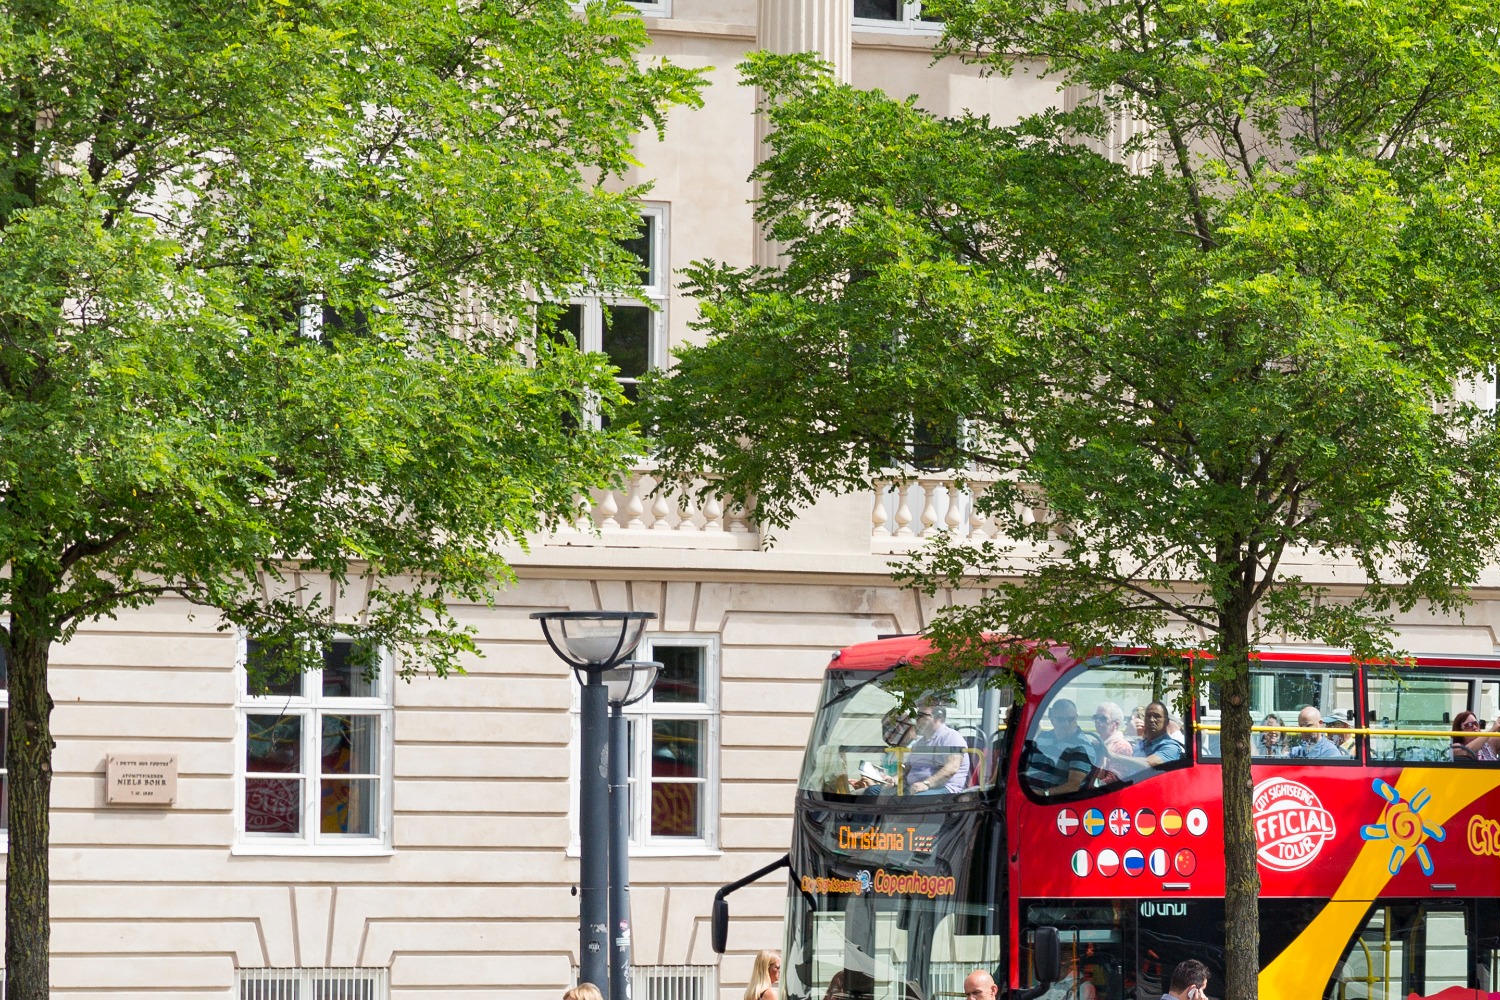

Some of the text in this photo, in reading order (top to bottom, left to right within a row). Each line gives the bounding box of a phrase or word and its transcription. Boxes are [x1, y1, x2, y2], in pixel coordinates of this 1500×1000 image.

[1255, 784, 1315, 812] CITY SIGHTSEEING
[839, 825, 904, 851] Christiania
[1254, 811, 1332, 843] FFICIAL
[1278, 836, 1316, 859] TOUR
[816, 876, 862, 896] Sightseeing
[874, 868, 955, 899] Copenhagen
